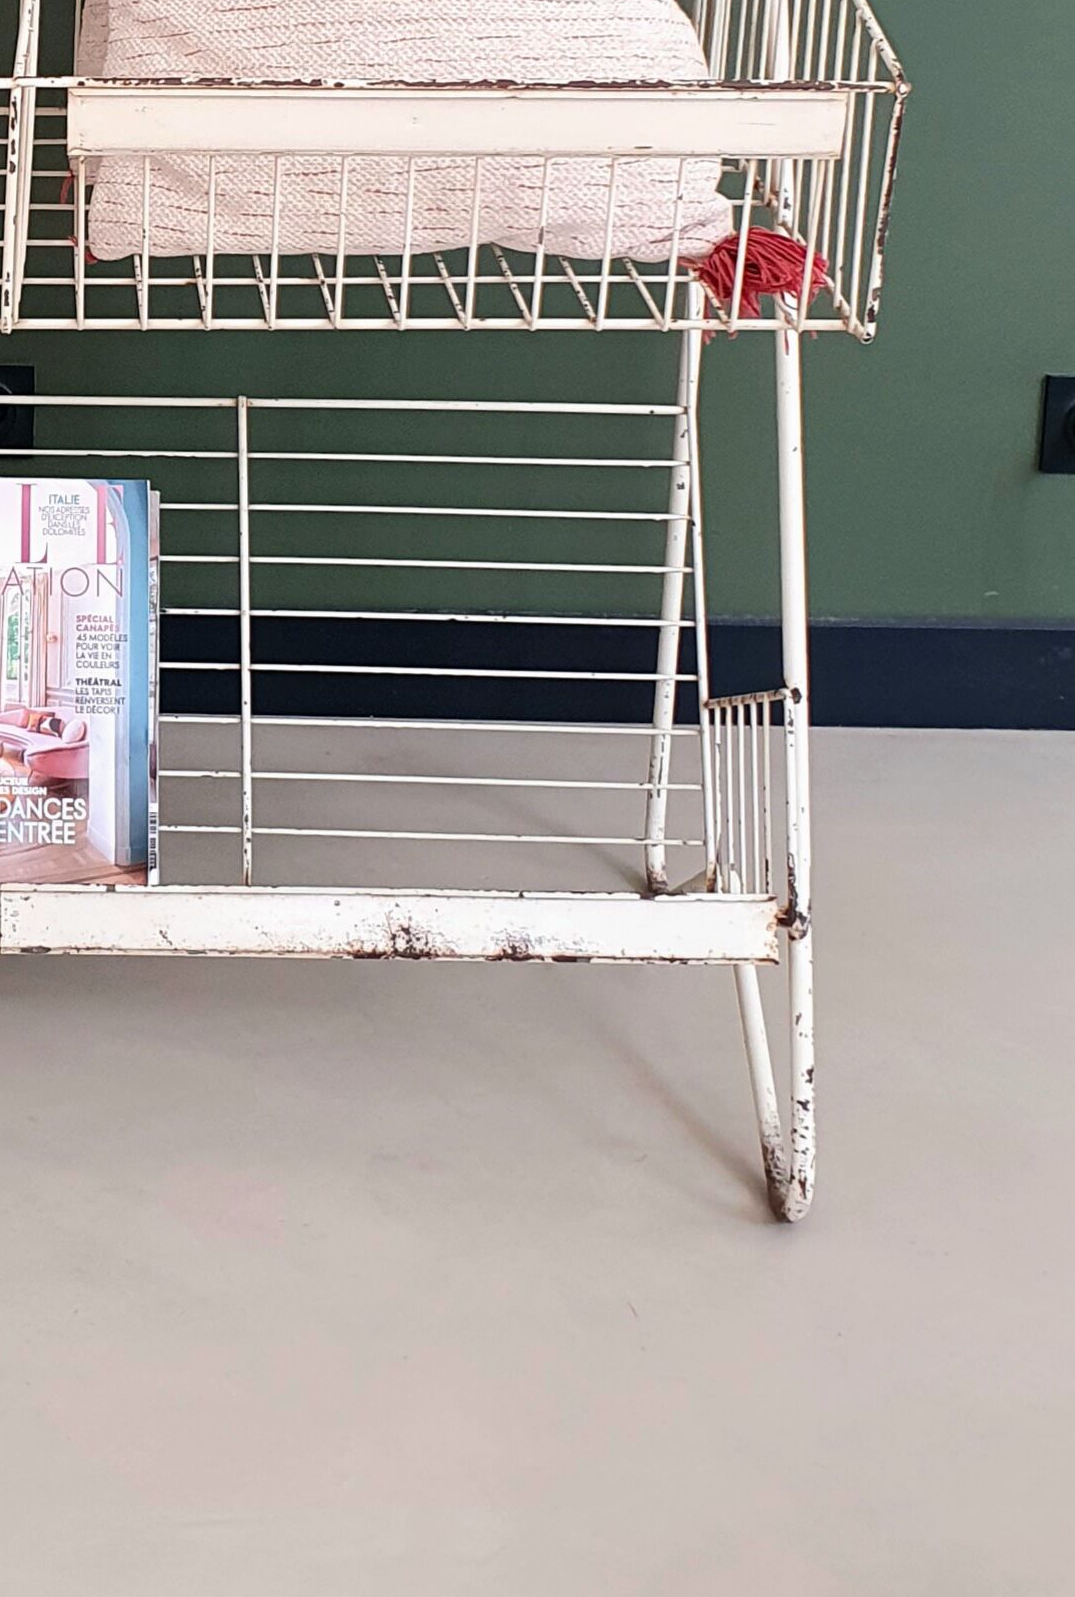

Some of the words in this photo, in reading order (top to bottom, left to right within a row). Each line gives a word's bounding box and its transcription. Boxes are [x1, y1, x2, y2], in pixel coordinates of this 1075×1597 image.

[48, 494, 81, 505] ITALIE
[75, 614, 114, 623] SPÉCIAL
[77, 633, 88, 642] 45
[75, 642, 99, 651] POUR
[101, 643, 120, 651] VOIR
[87, 652, 100, 660] VIE
[101, 652, 112, 660] EN
[75, 661, 120, 669] COULEURS
[75, 688, 89, 696] LES
[91, 688, 112, 696] TAPIS
[75, 706, 85, 714] LE
